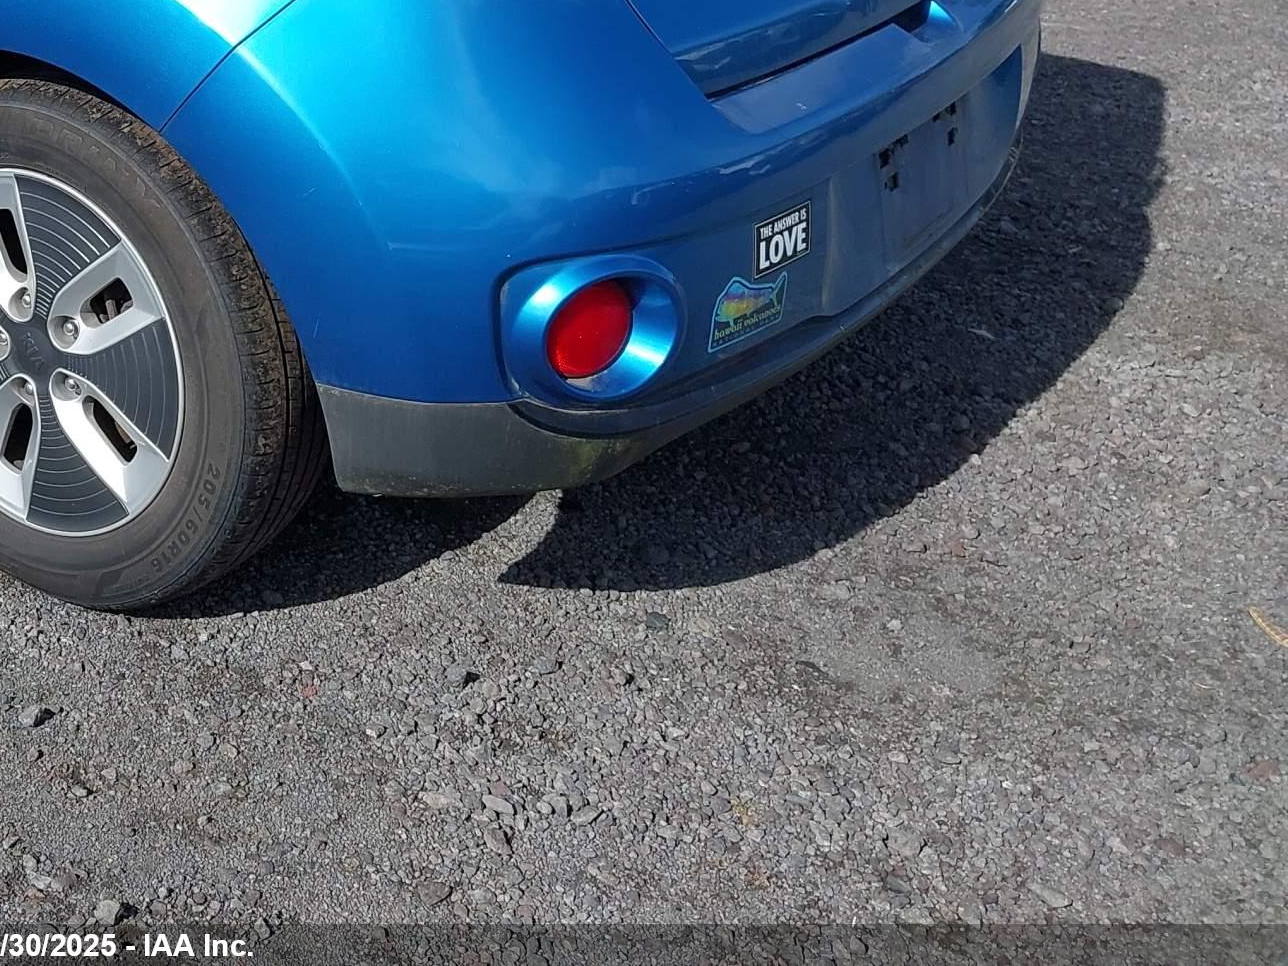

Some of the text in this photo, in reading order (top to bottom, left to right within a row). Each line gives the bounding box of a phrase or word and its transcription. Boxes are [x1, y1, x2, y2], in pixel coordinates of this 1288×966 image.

[759, 208, 807, 240] THE ANSWER IS
[759, 221, 808, 270] LOVE
[150, 462, 221, 574] 205/60R16
